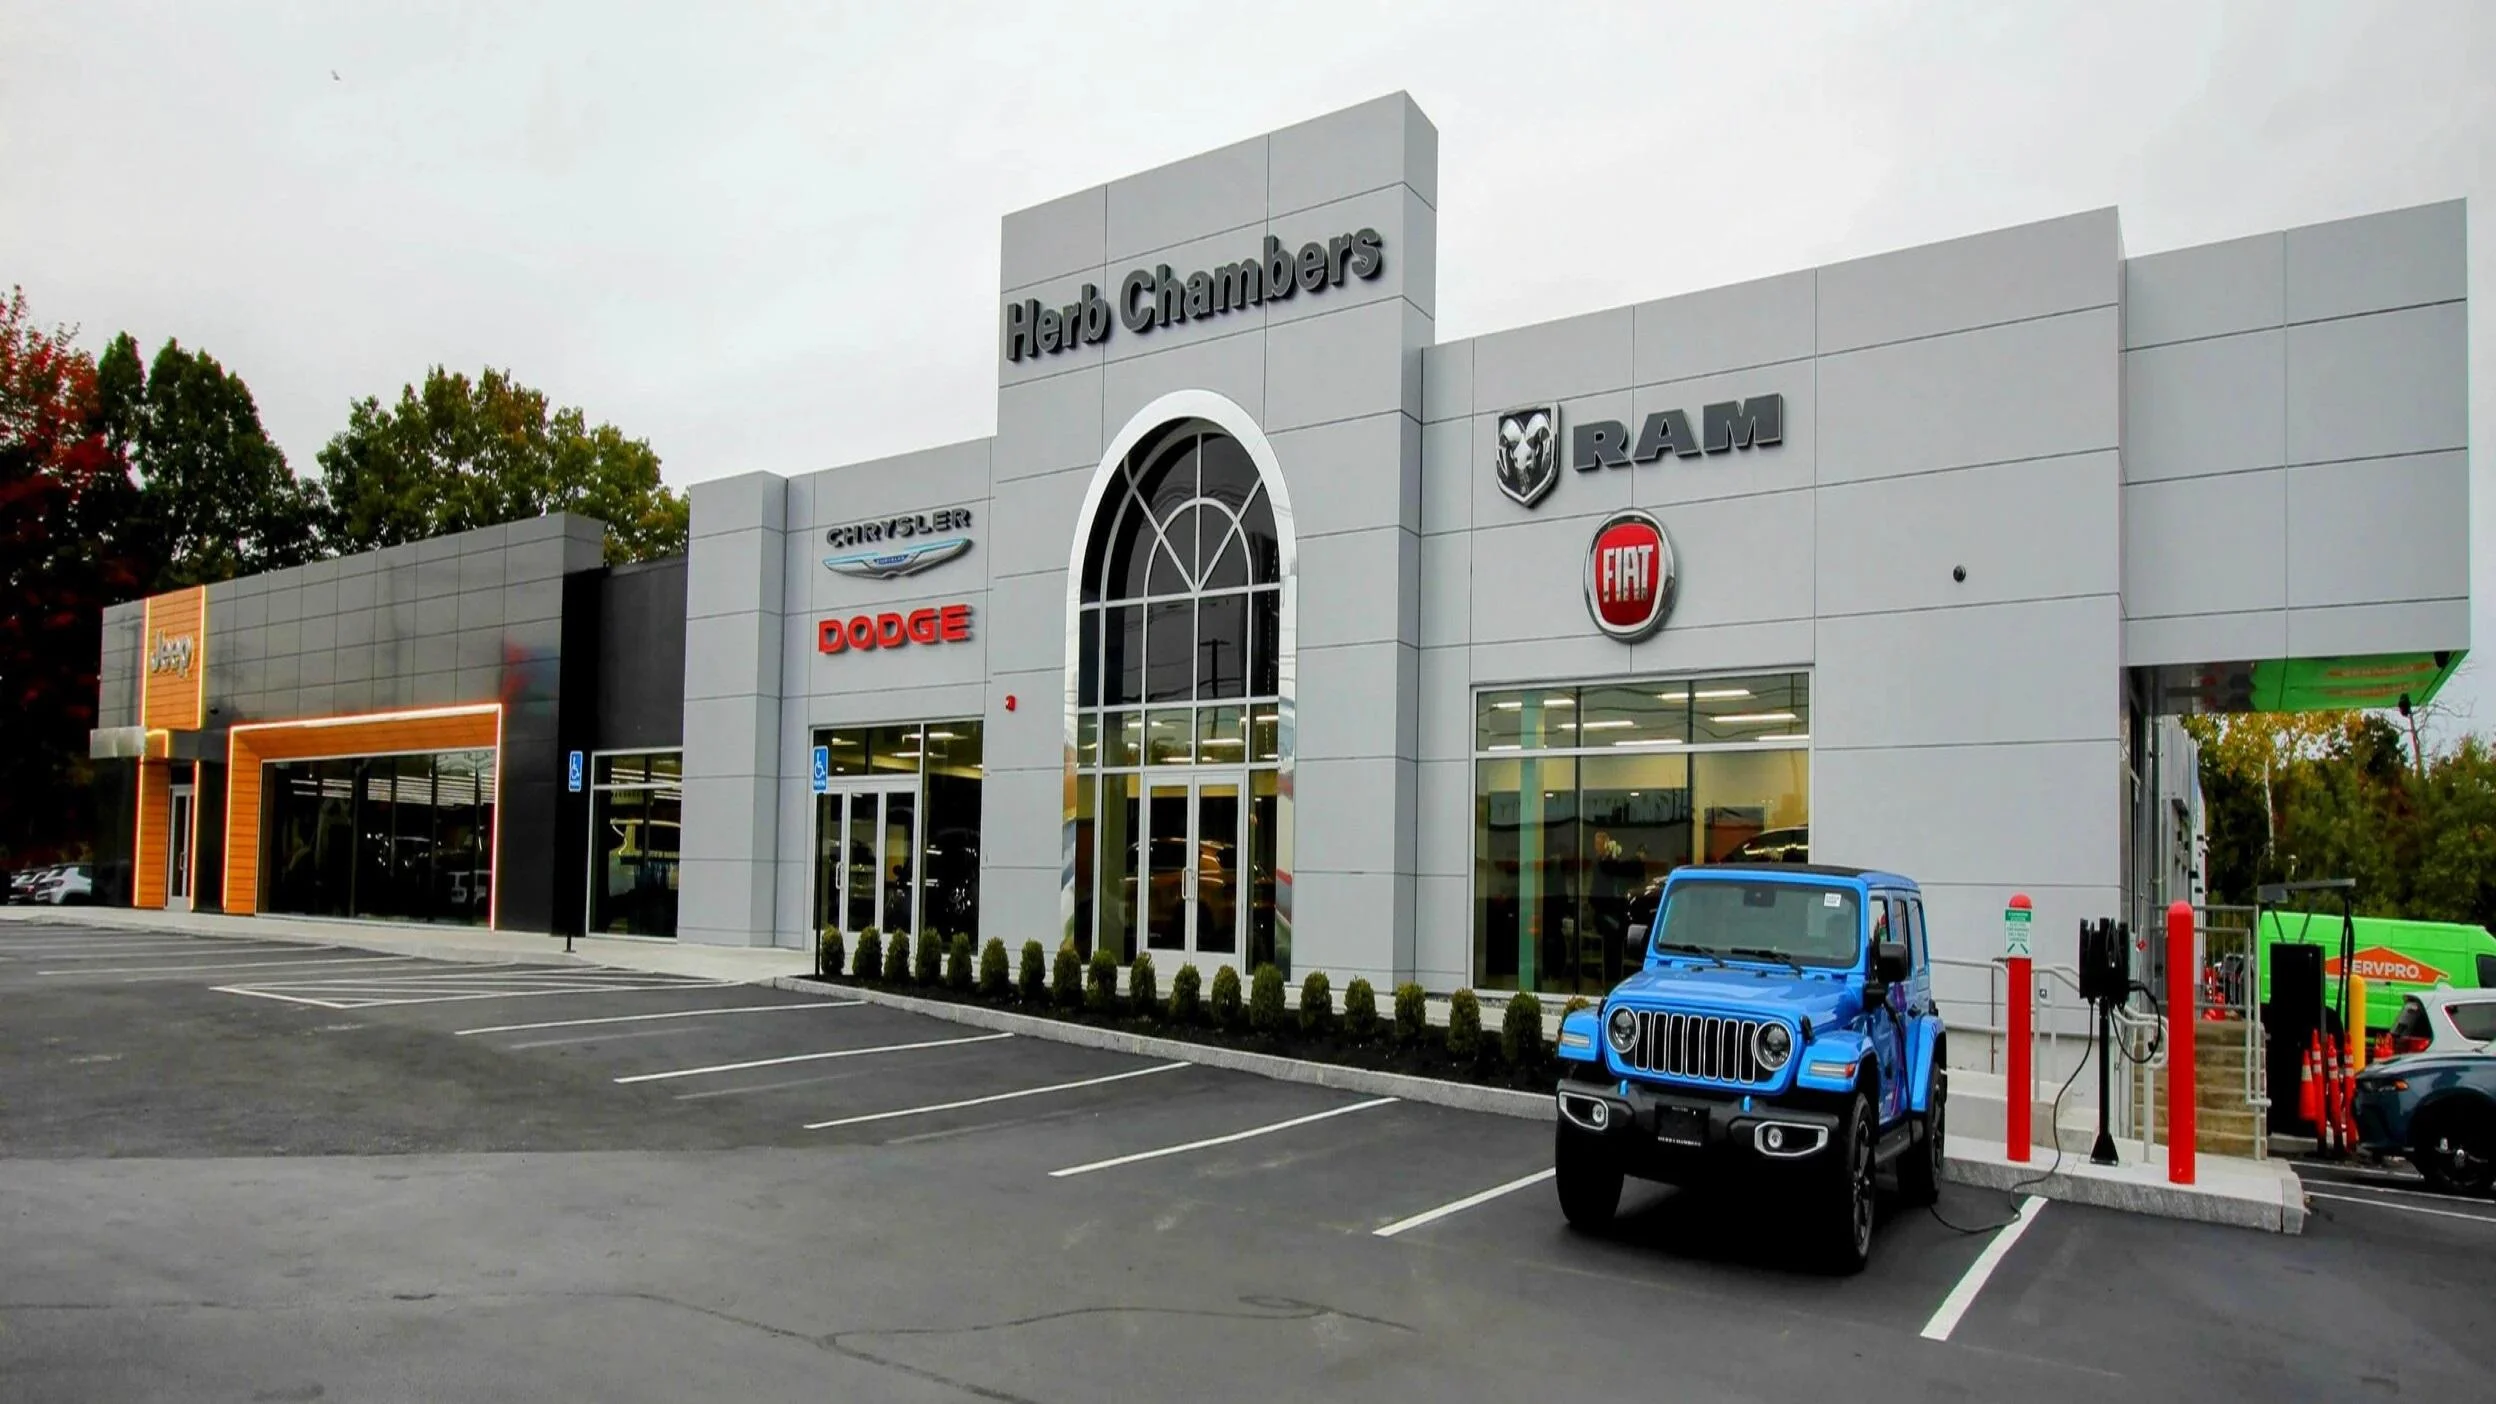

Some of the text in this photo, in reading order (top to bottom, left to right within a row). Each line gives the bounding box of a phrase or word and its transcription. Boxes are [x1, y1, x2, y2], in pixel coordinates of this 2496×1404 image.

[1006, 227, 1383, 361] Herb Chambers
[1573, 393, 1783, 472] RAM
[827, 508, 972, 548] CHRYSLER
[1602, 544, 1654, 603] FIAT
[151, 629, 194, 678] Jeep
[818, 604, 971, 655] DODGE
